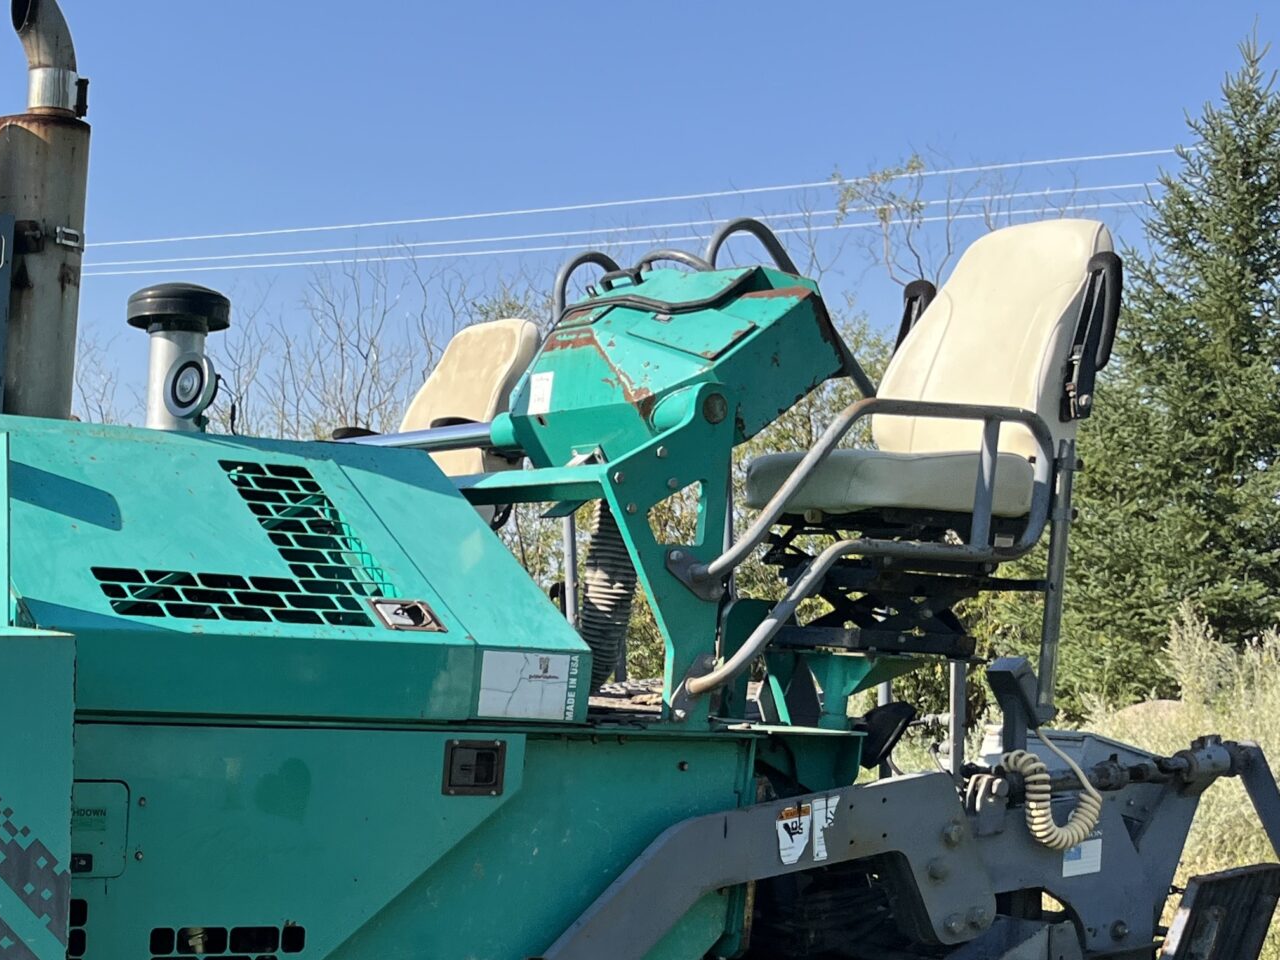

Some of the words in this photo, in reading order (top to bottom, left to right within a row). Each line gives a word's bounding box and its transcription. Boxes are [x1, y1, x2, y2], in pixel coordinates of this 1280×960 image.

[570, 655, 579, 675] USA
[568, 678, 577, 688] IN
[565, 692, 576, 720] MADE
